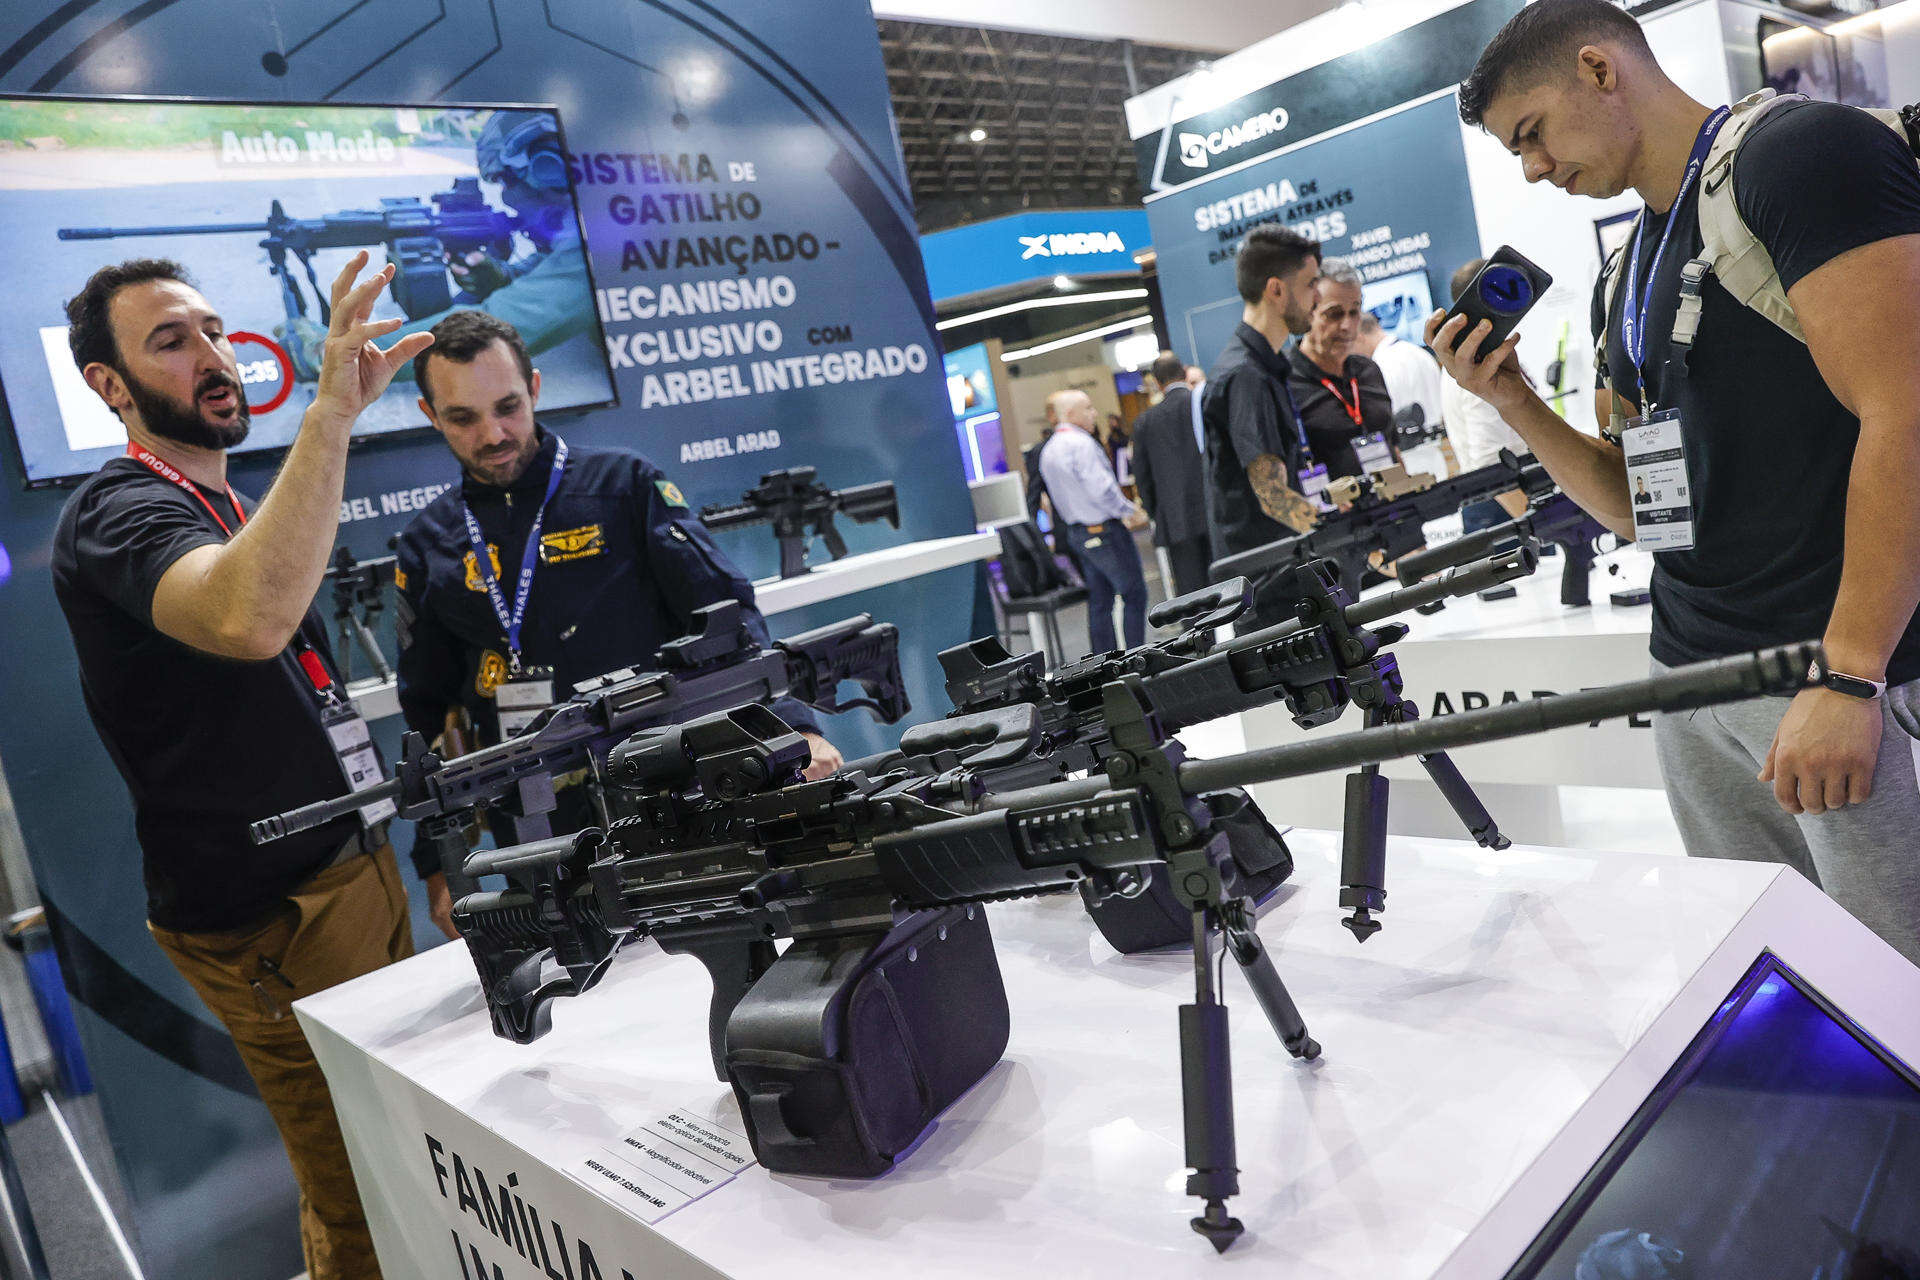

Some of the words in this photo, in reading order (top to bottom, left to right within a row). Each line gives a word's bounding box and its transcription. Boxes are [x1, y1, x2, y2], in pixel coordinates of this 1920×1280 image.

[222, 130, 300, 163] Auto
[304, 129, 396, 162] Mode
[1205, 107, 1289, 155] CAMERO
[570, 153, 718, 186] SISTEMA
[728, 161, 757, 182] DE
[608, 192, 761, 226] GATILHO
[1194, 178, 1298, 232] SISTEMA
[607, 319, 782, 369] XCLUSIVO
[807, 326, 853, 346] COM
[641, 364, 751, 409] ARBEL
[752, 343, 929, 394] INTEGRADO
[138, 451, 180, 481] GROUP
[680, 434, 736, 463] ARBEL
[736, 429, 782, 452] ARAD
[486, 575, 511, 629] THALES
[513, 568, 532, 625] THALES
[699, 1129, 731, 1146] compacta
[585, 1159, 606, 1172] NEGEV
[649, 1197, 666, 1208] LMG
